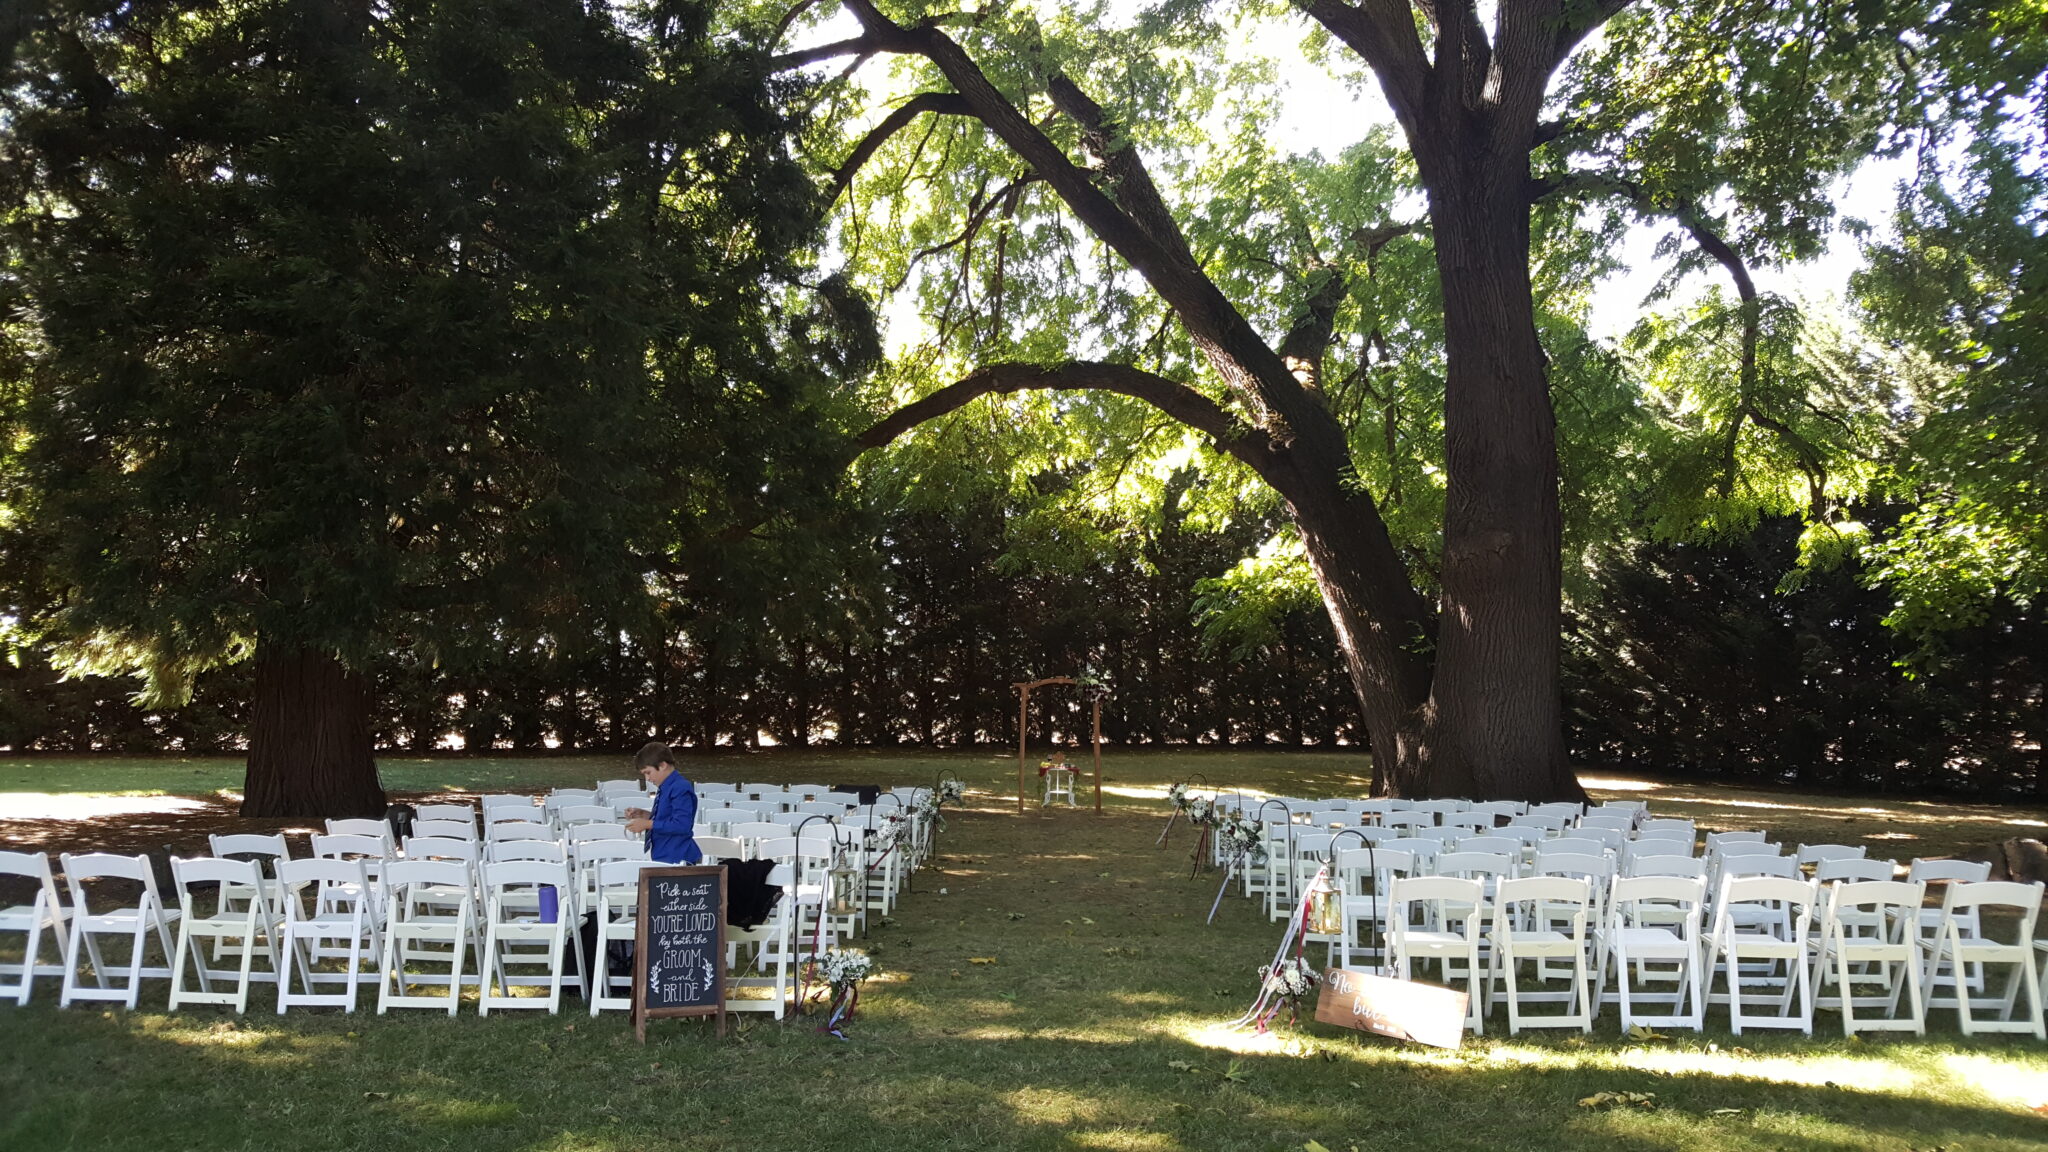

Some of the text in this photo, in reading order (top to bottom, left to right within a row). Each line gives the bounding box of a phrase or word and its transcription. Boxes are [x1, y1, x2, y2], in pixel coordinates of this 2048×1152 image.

[655, 882, 681, 899] Pick
[692, 883, 711, 896] seat
[660, 897, 708, 911] either side
[685, 913, 716, 933] LOVED
[659, 934, 708, 950] by both the
[663, 949, 702, 969] GROOM
[667, 968, 696, 981] and
[663, 982, 700, 1003] BRIDE
